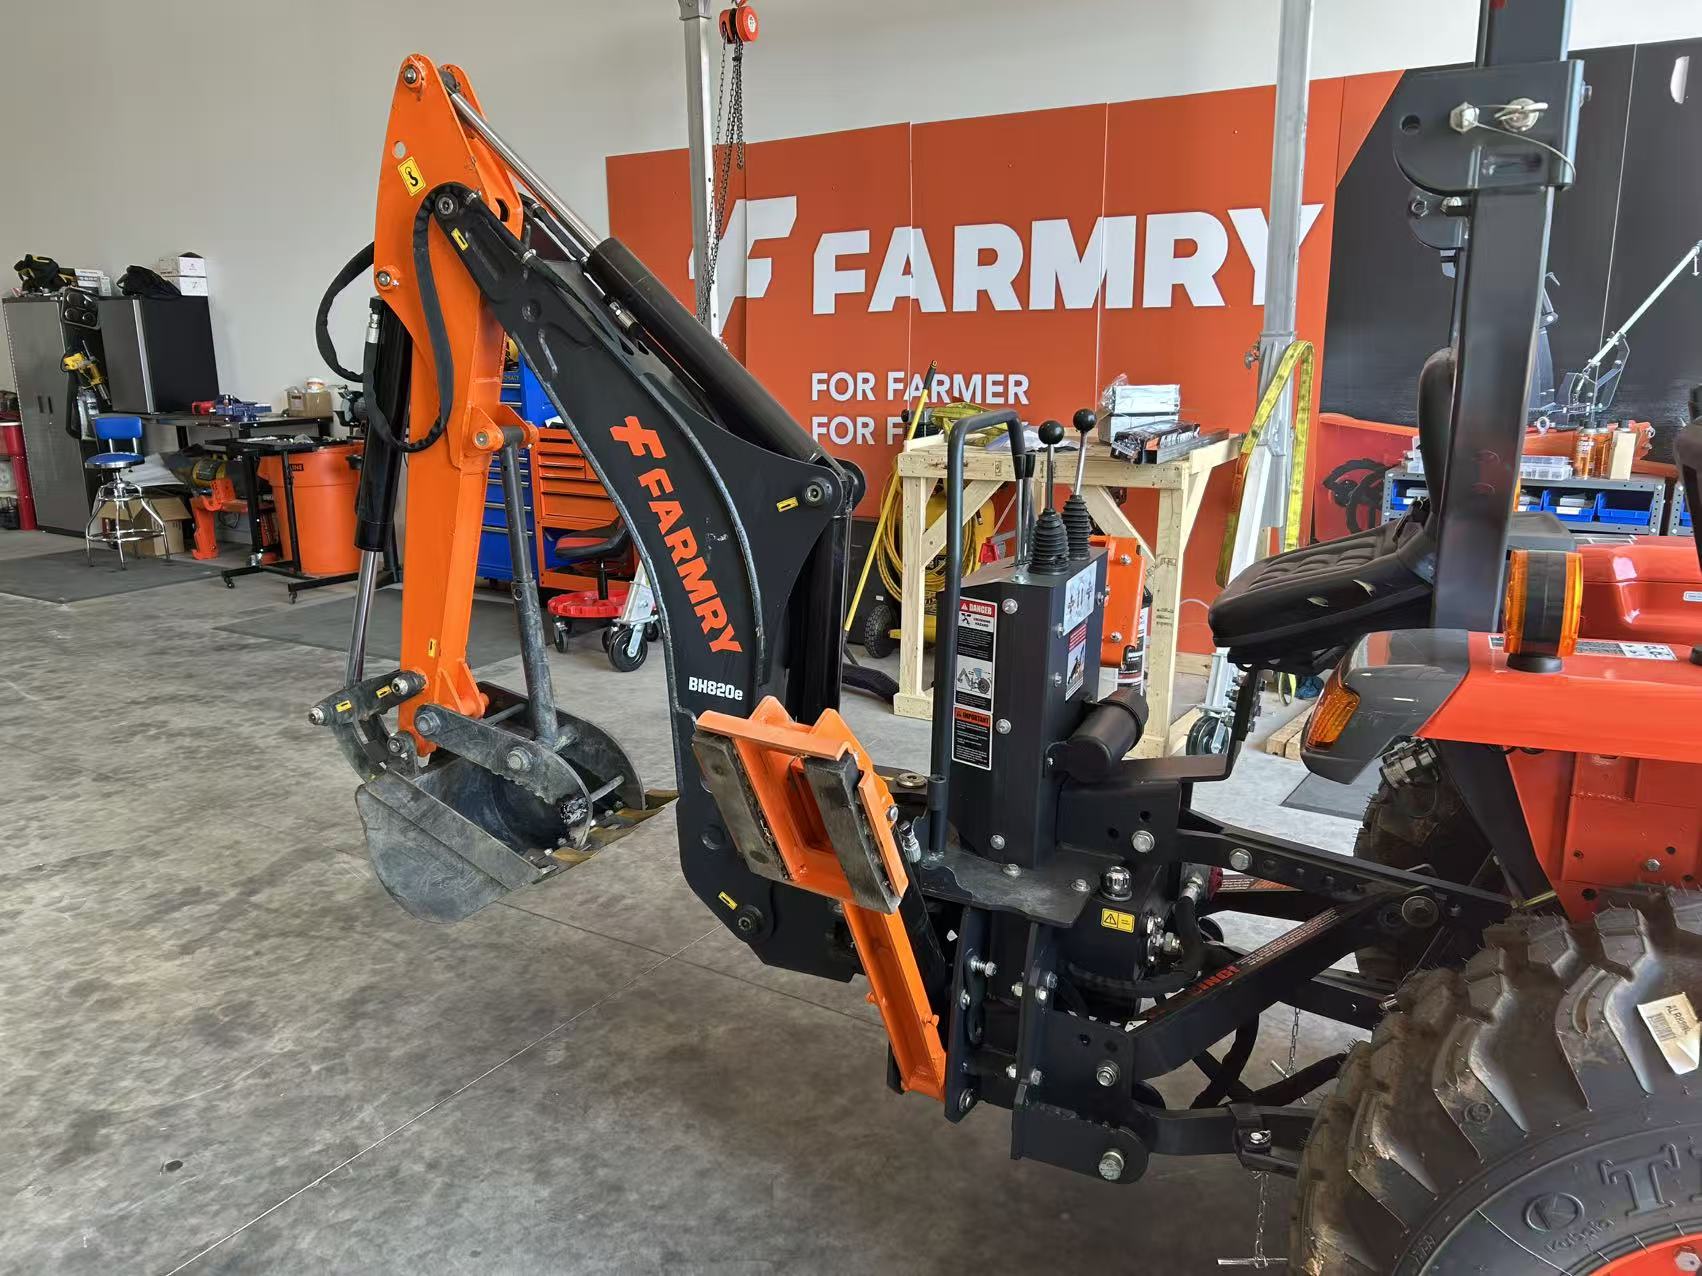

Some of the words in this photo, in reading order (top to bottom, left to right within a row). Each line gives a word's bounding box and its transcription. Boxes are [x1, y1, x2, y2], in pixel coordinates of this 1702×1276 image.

[812, 203, 1325, 315] FARMRY
[811, 371, 876, 402] FOR
[886, 371, 1030, 405] FARMER
[811, 415, 875, 445] FOR
[638, 469, 743, 653] FARMRY
[969, 604, 992, 615] DANGER
[688, 676, 743, 701] BH820e
[962, 711, 989, 725] IMPORTANT
